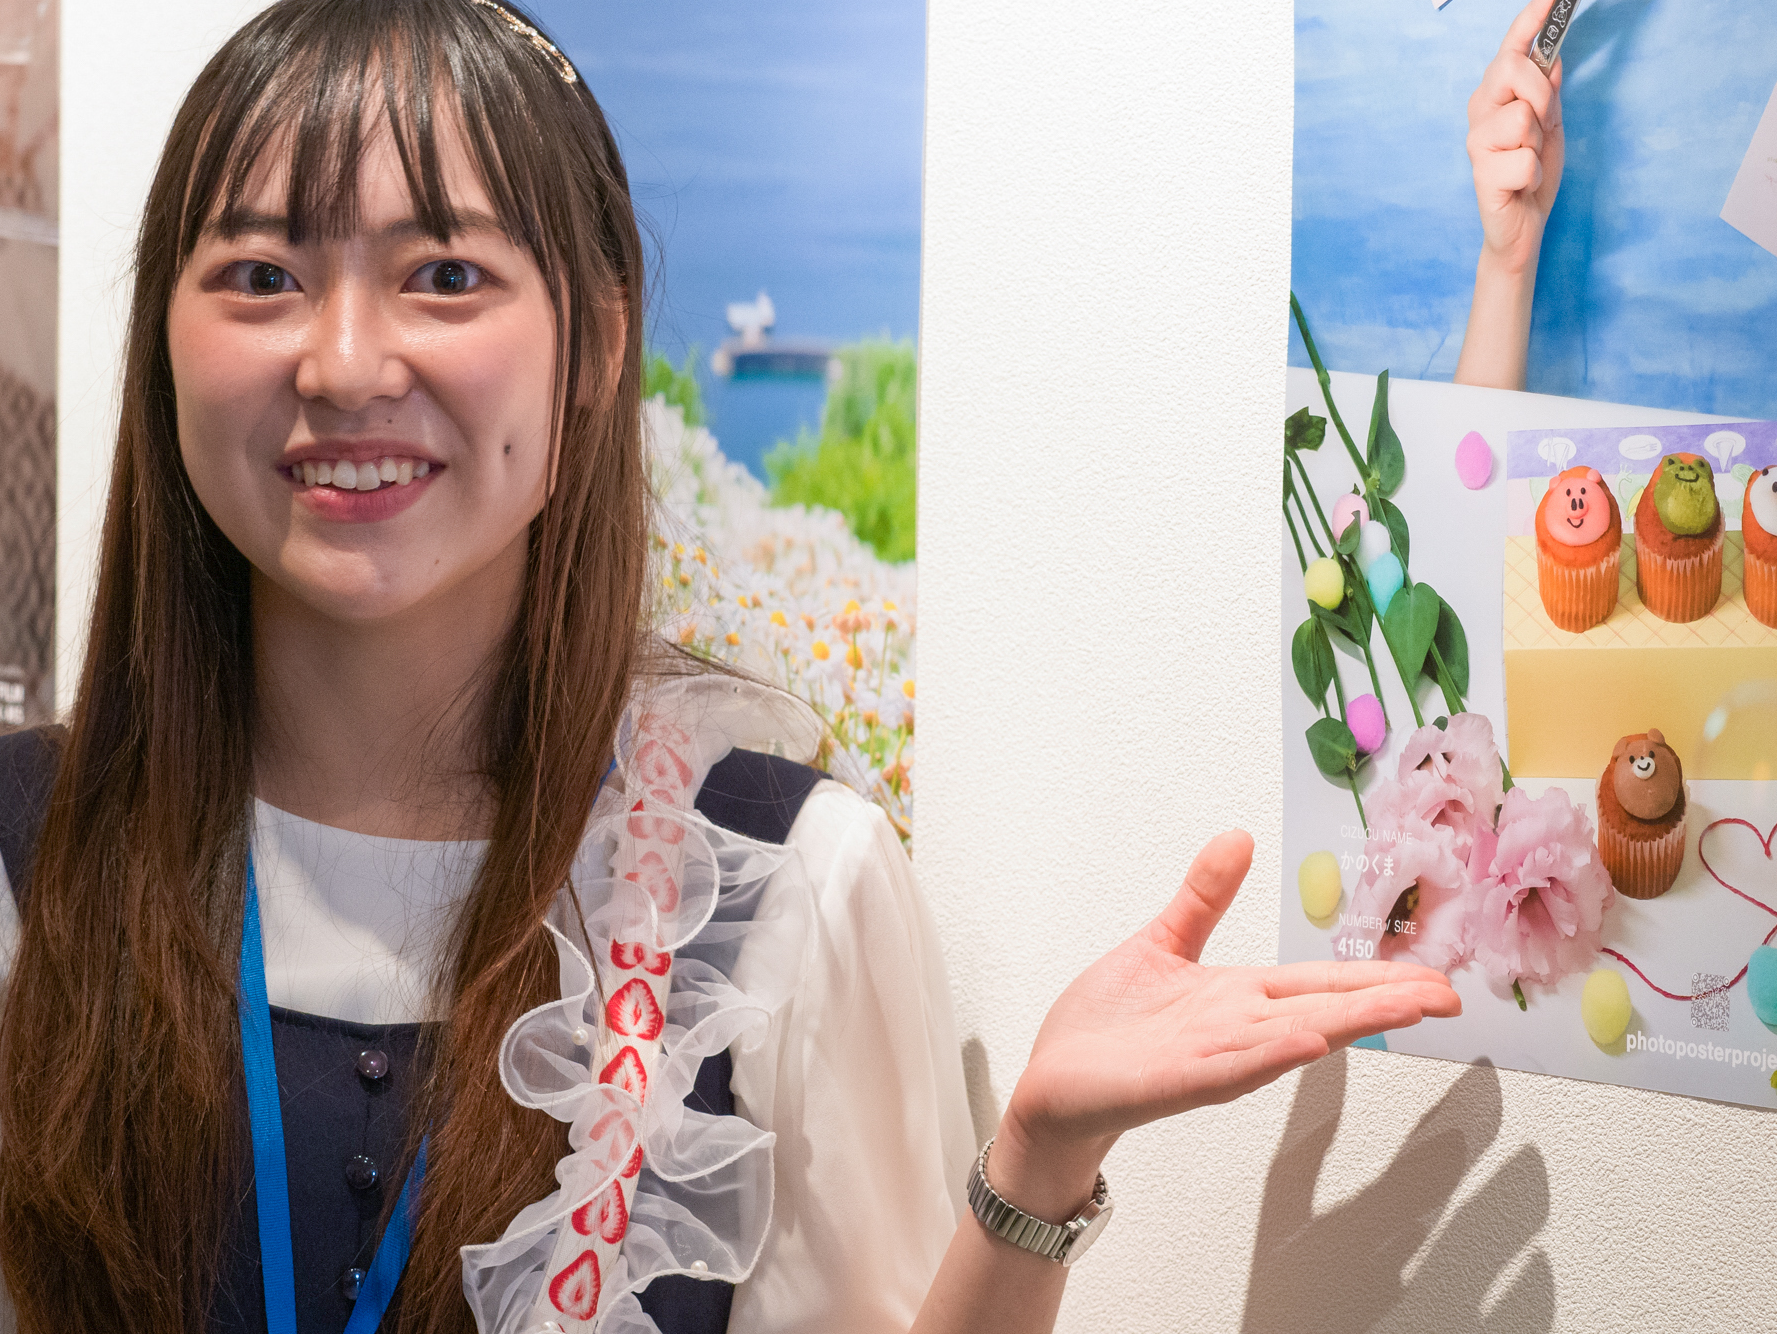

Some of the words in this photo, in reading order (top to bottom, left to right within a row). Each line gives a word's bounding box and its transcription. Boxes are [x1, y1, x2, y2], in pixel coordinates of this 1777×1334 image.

[1340, 824, 1379, 841] CIZUCU
[1382, 830, 1413, 845] NAME
[1340, 850, 1395, 877] かのくま
[1338, 913, 1383, 931] NUMBER
[1394, 919, 1417, 935] SIZE
[1338, 936, 1374, 960] 4150
